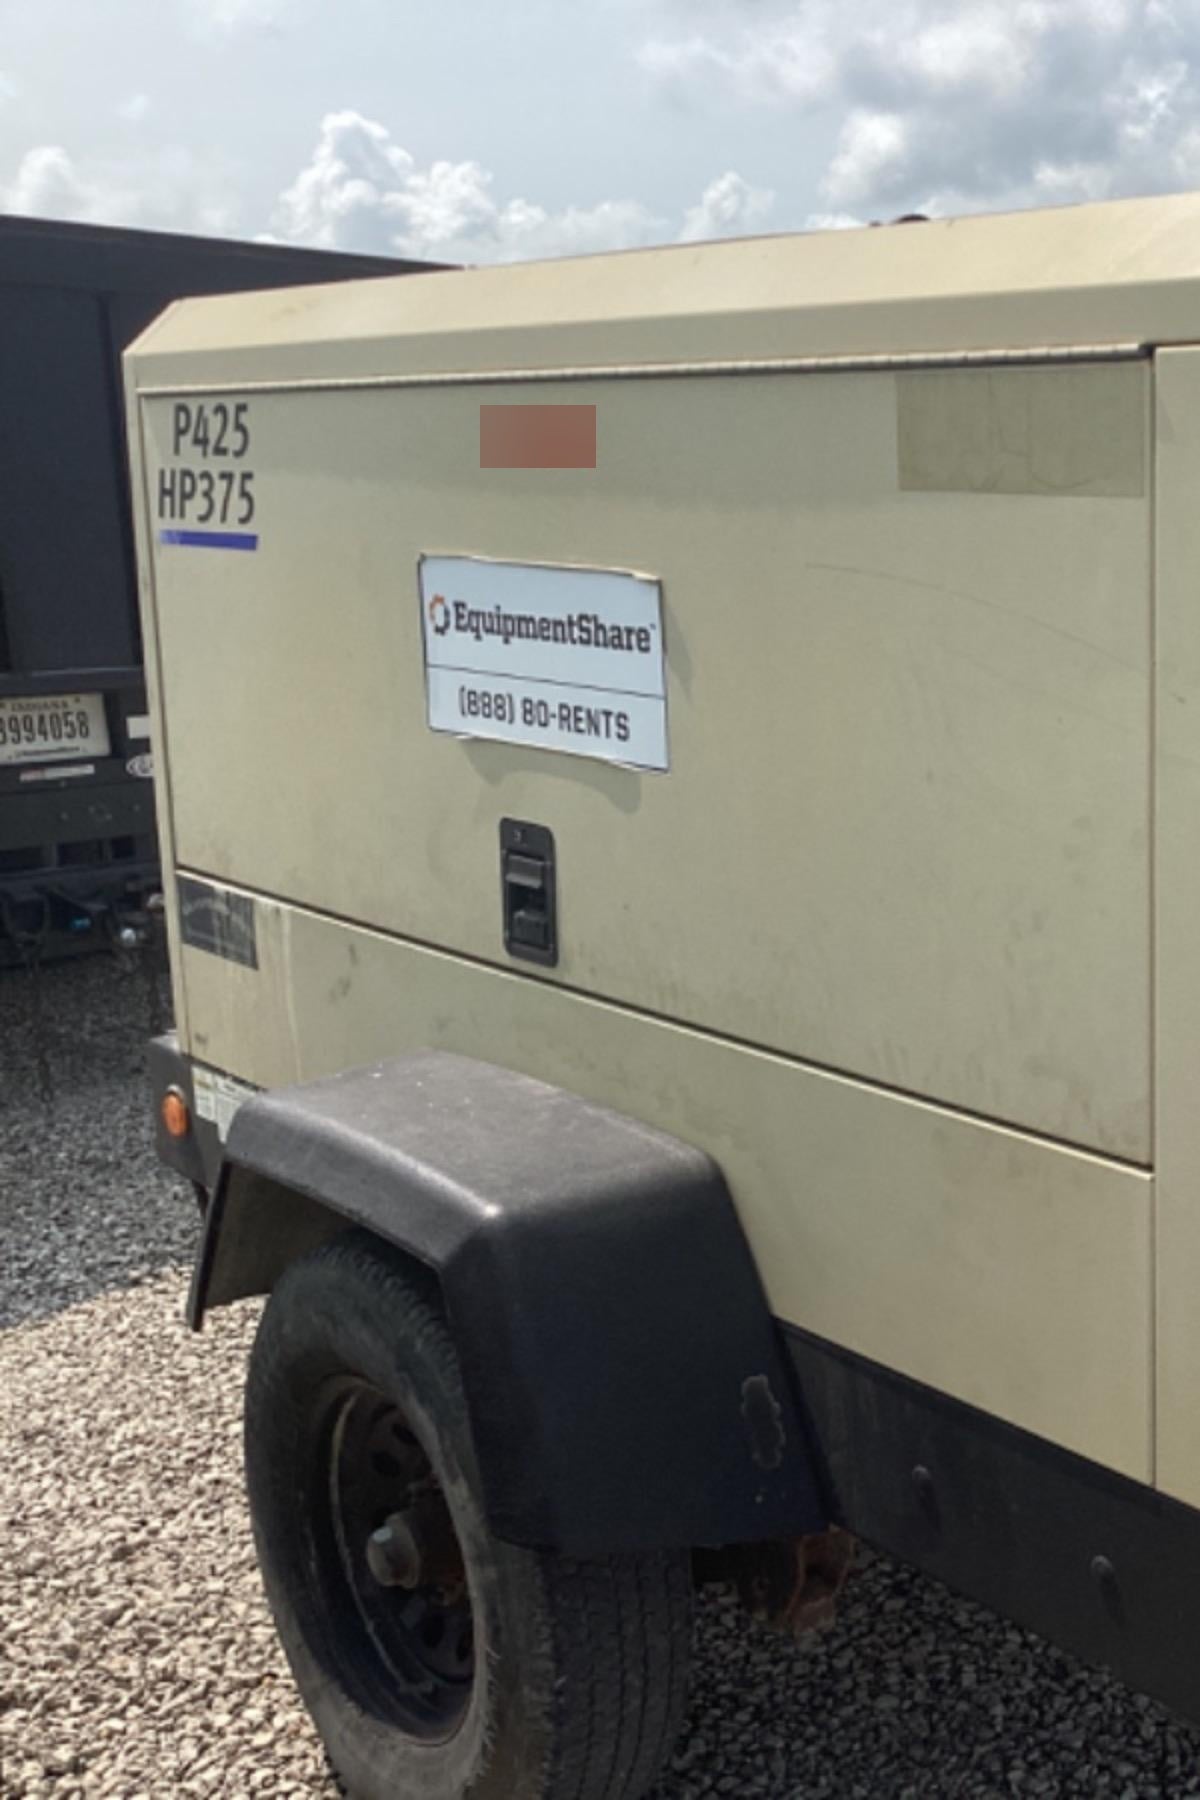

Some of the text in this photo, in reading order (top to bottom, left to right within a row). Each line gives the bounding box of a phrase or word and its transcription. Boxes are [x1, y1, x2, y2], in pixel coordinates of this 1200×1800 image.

[173, 402, 249, 459] P425
[157, 467, 255, 525] HP375
[451, 600, 652, 654] EquipmentShare
[458, 685, 515, 725] (888)
